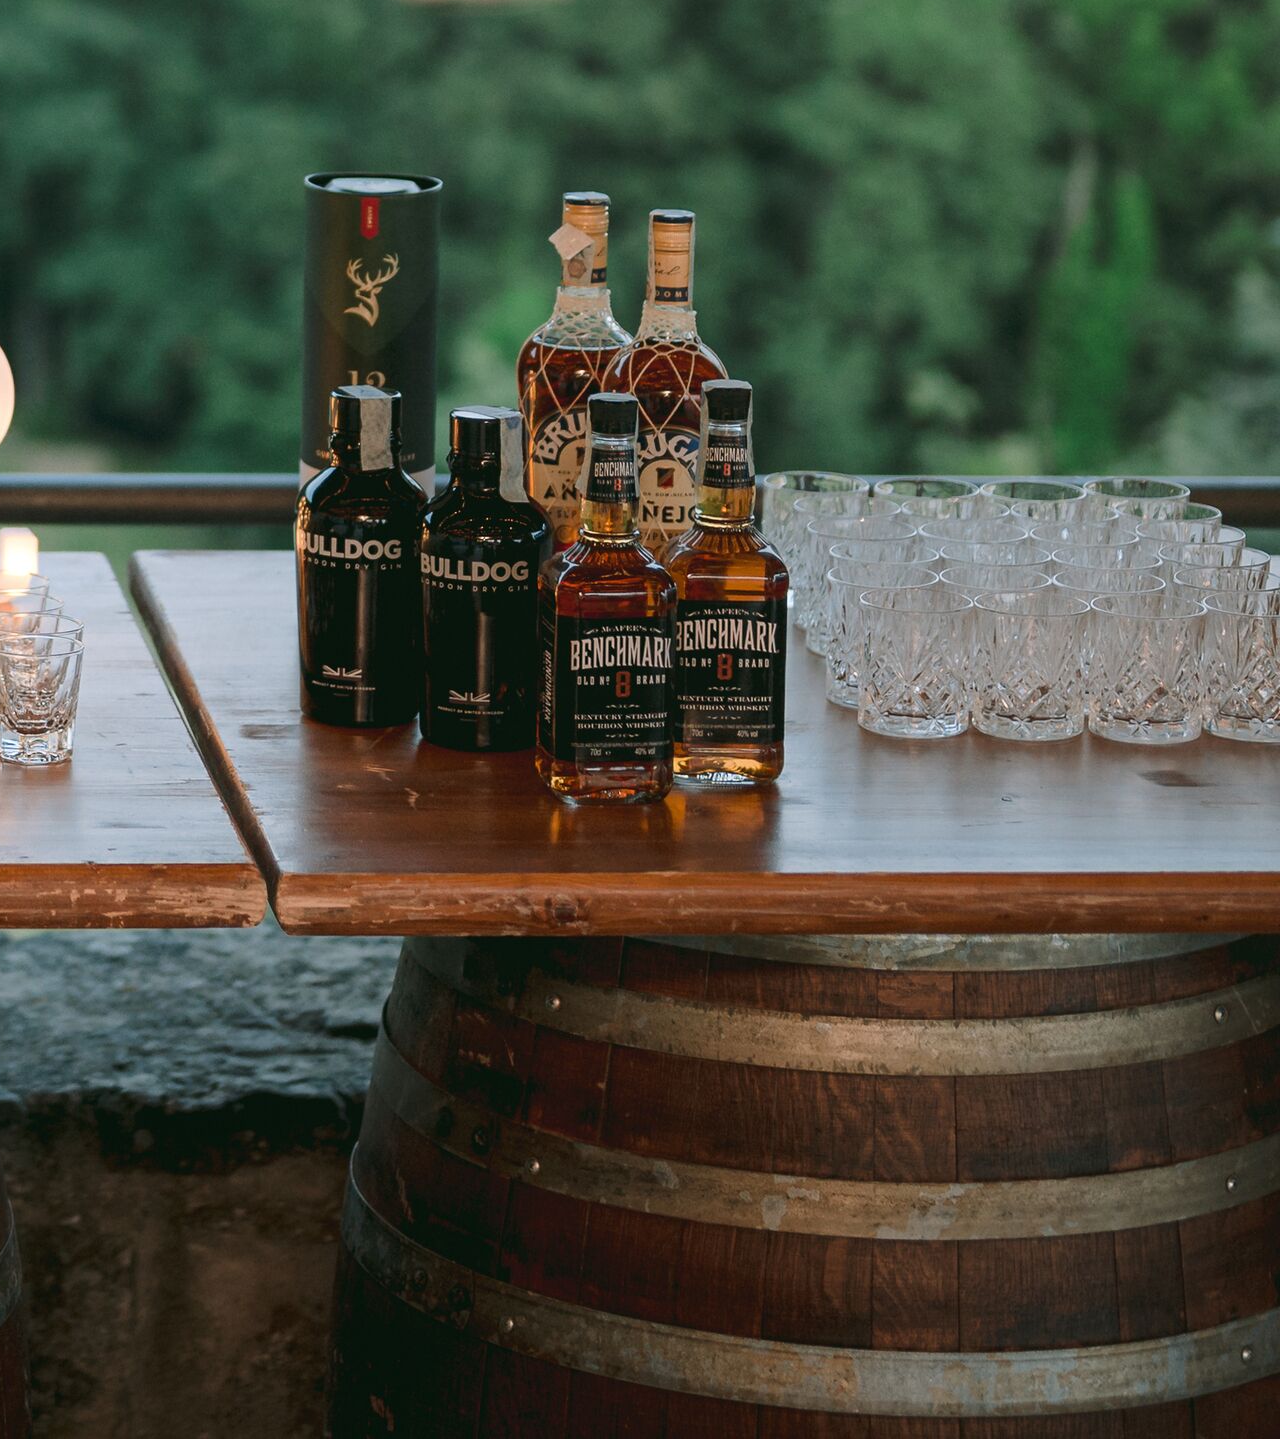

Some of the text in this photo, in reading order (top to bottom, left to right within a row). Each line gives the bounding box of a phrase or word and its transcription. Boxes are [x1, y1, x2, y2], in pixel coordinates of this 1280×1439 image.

[420, 552, 529, 582] BULLDOG
[421, 576, 463, 591] LONDON
[676, 618, 777, 653] BENCHMARK
[570, 635, 672, 671] BENCHMARK
[717, 653, 734, 681] 8
[738, 658, 770, 668] BRAND
[577, 676, 595, 685] OLD
[615, 671, 631, 698] 8
[636, 674, 666, 685] BRAND
[727, 695, 773, 703] STRAIGHT
[574, 711, 668, 721] KENTUCKY STRAIGHT
[626, 721, 666, 729] WHISKEY
[737, 730, 749, 738] 40%
[590, 748, 602, 756] 70cl
[647, 747, 656, 755] vol
